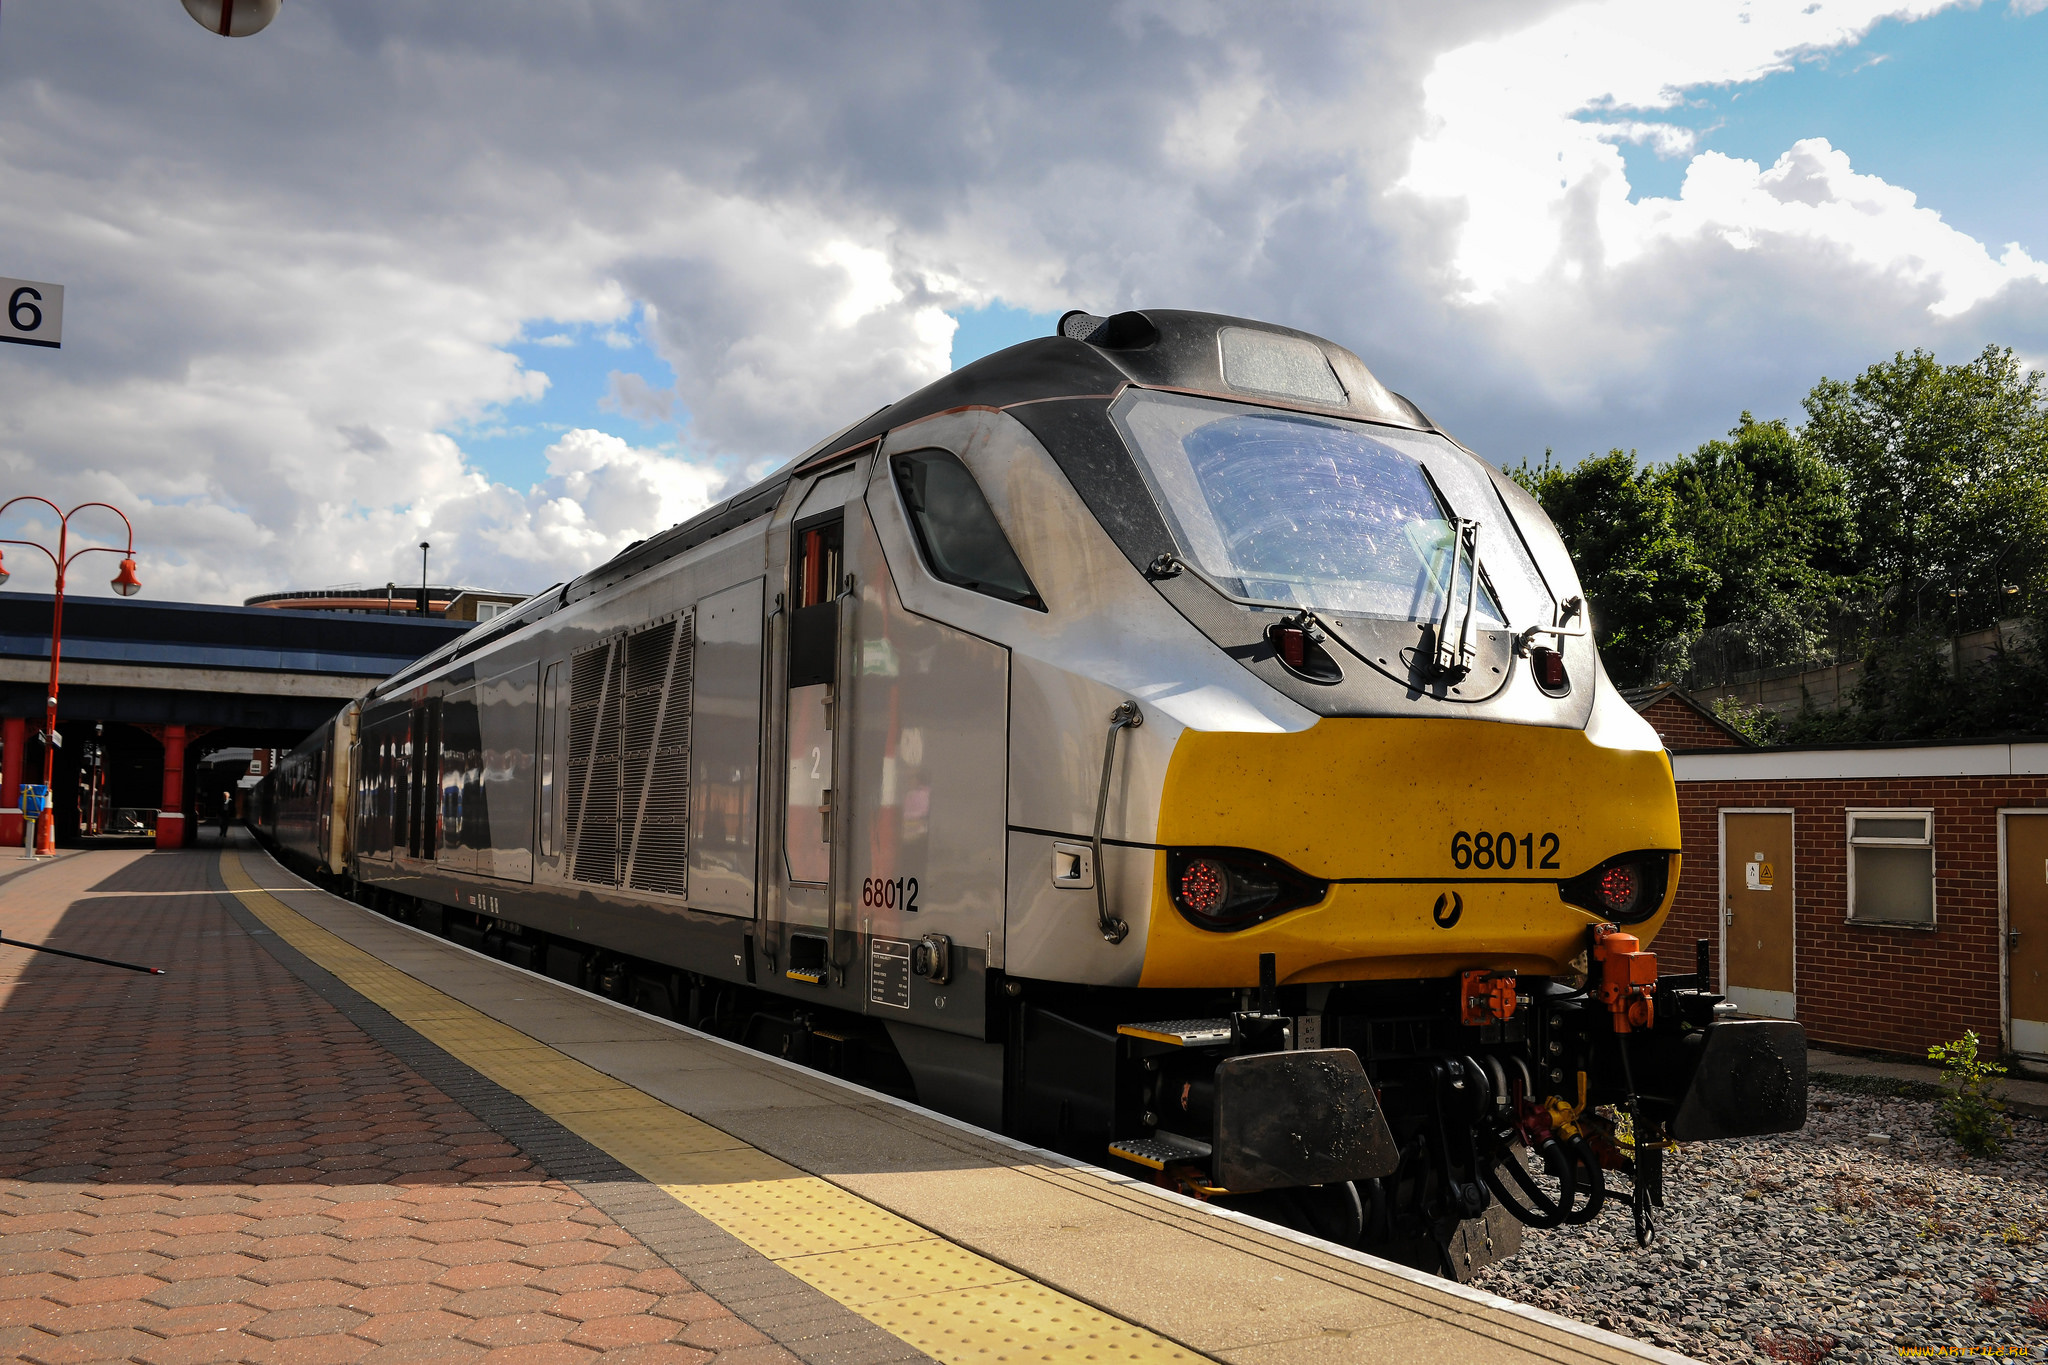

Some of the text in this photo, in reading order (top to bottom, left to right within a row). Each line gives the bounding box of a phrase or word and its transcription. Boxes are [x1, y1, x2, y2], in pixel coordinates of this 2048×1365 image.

[8, 287, 42, 331] 6
[811, 747, 821, 779] 2
[1451, 831, 1560, 869] 68012
[862, 877, 919, 912] 68012
